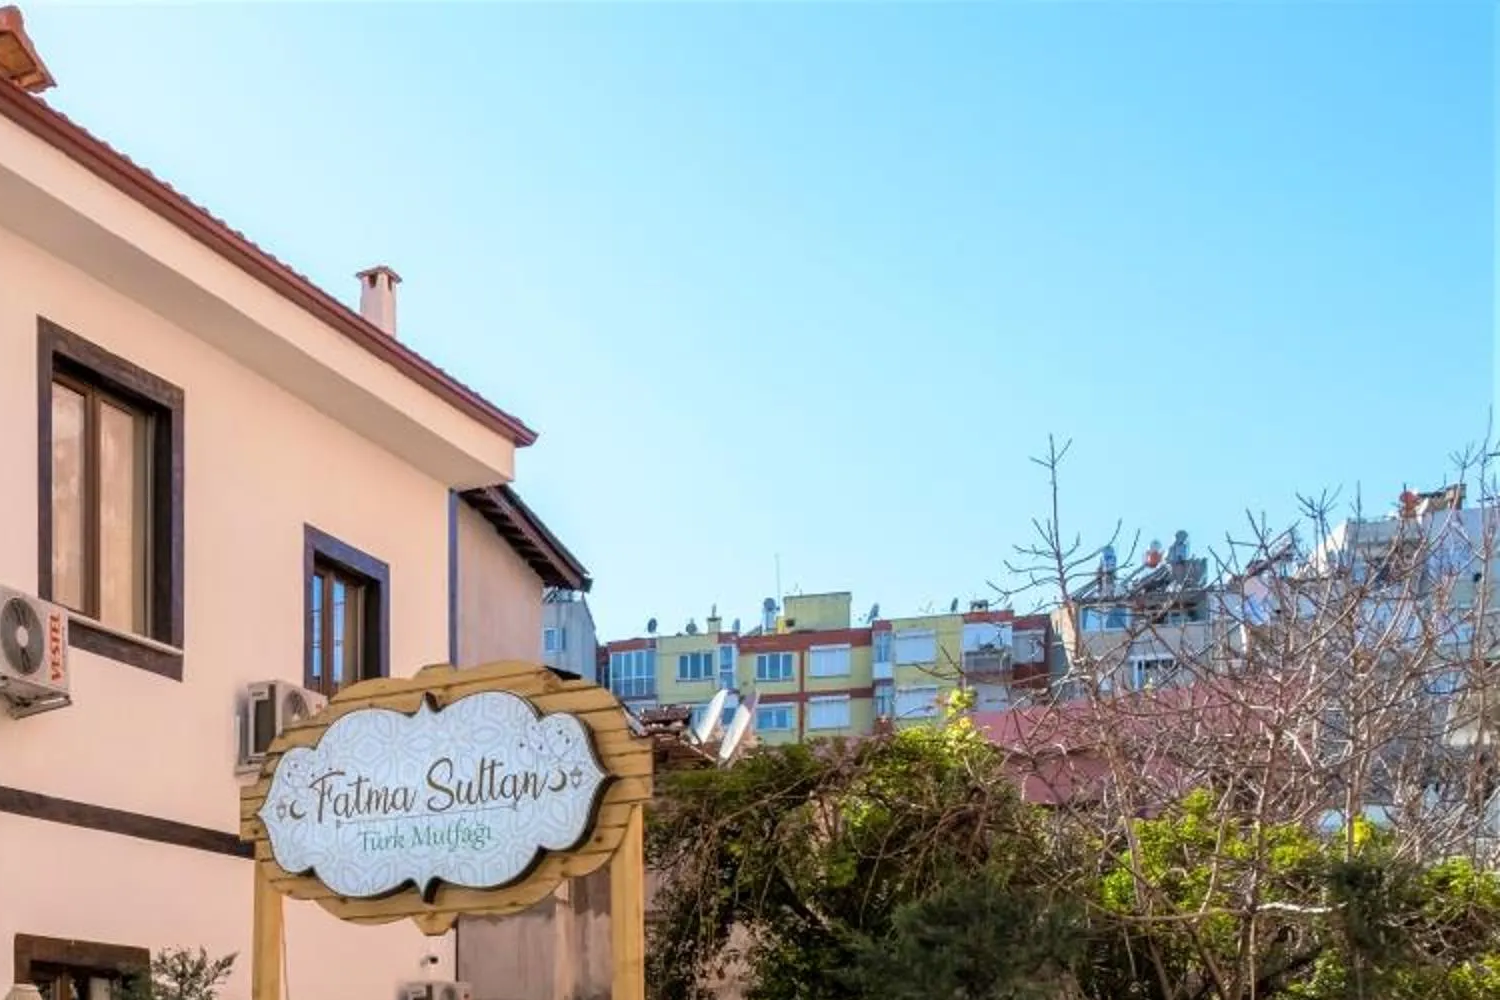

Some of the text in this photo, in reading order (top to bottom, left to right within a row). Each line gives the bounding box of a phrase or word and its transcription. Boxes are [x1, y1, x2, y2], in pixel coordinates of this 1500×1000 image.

[50, 611, 62, 680] VESTEL
[308, 756, 551, 823] Fatma Sultan
